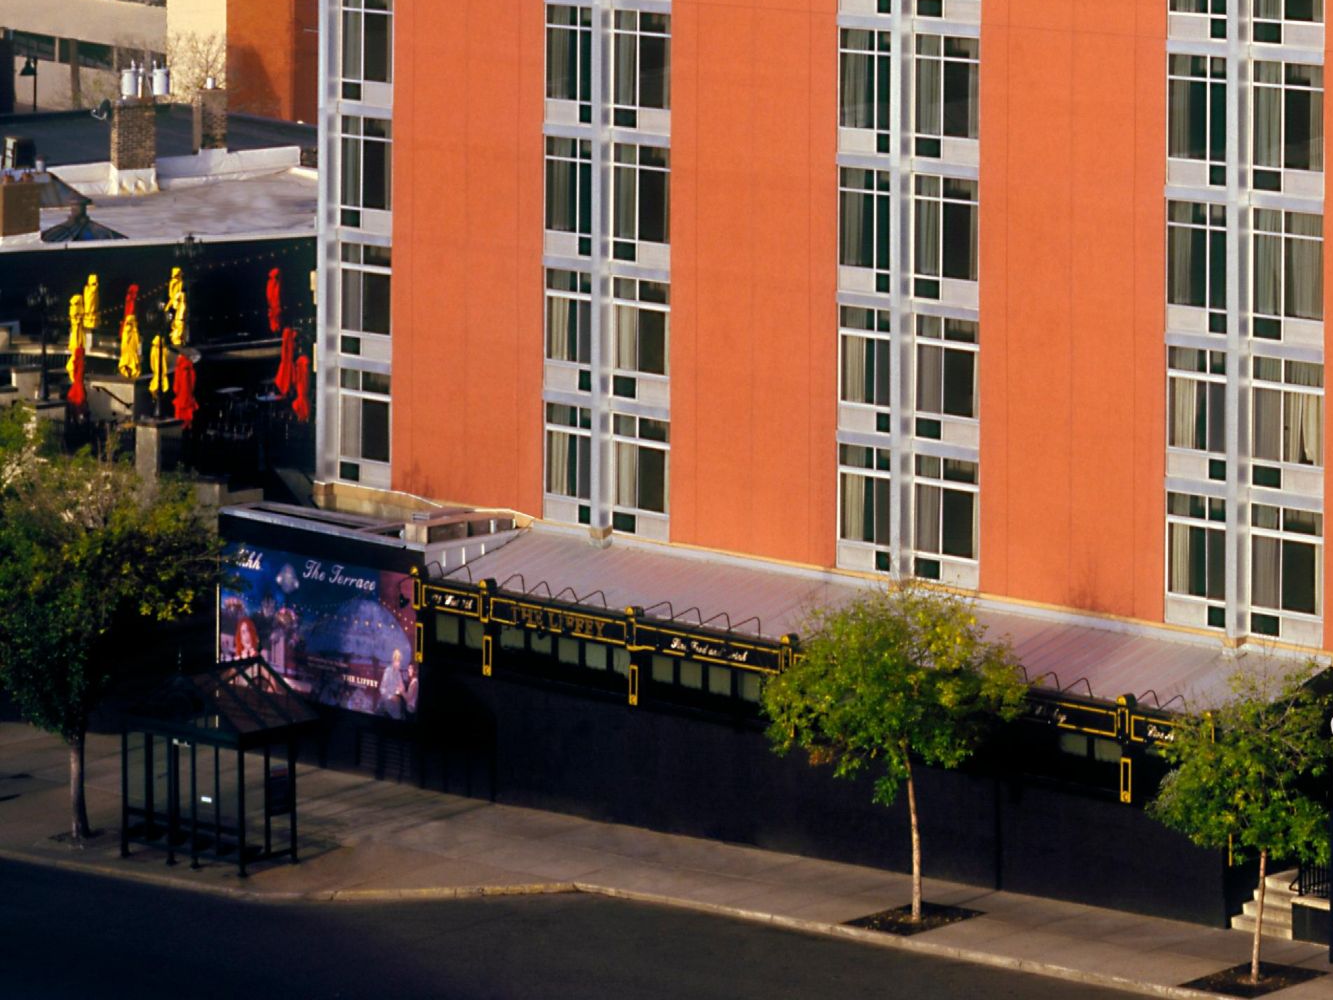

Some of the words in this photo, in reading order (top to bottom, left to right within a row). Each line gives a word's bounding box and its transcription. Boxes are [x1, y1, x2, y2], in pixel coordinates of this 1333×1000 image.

[302, 559, 326, 582] The
[328, 564, 377, 591] Terrace
[511, 606, 543, 627] THE
